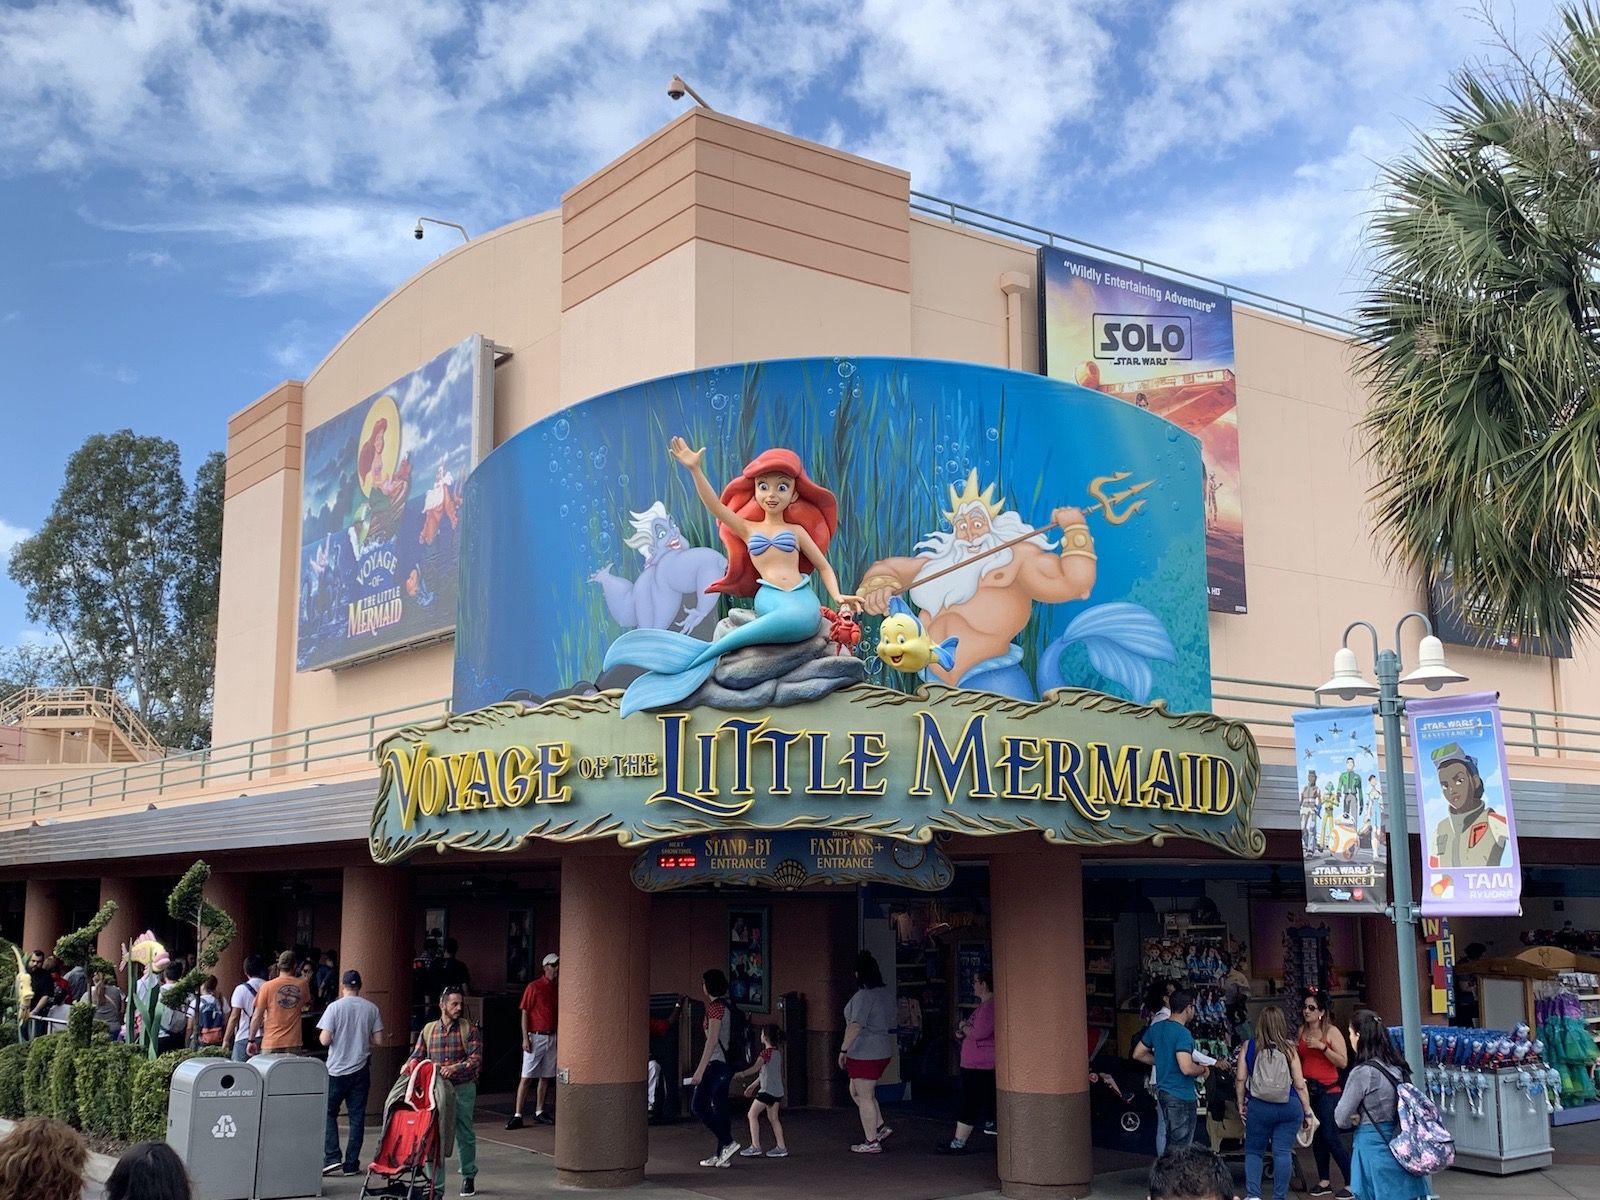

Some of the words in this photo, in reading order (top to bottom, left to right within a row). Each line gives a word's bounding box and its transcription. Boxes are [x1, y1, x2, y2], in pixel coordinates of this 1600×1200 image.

[1104, 272, 1161, 301] Entertaining
[1101, 323, 1185, 352] SOLO
[1113, 357, 1140, 366] STAR
[1141, 357, 1168, 366] WARS
[356, 551, 397, 586] VOYAGE
[363, 594, 376, 609] THE
[377, 586, 401, 605] LITTLE
[347, 598, 402, 638] MERMAID
[1421, 722, 1447, 731] STAR
[1447, 719, 1474, 729] WARS
[384, 741, 573, 831] VOYAGE
[578, 756, 609, 780] OF
[610, 753, 659, 778] THE
[644, 711, 890, 818] LITTLE
[908, 709, 1240, 821] MERMAID
[704, 838, 773, 857] STAND-BY
[810, 838, 884, 856] FASTPASS+
[710, 858, 767, 870] ENTRANCE
[817, 857, 874, 869] ENTRANCE
[1311, 866, 1340, 875] STAR
[1339, 866, 1368, 875] WARS
[1313, 877, 1367, 886] RESISTANCE
[1464, 872, 1513, 889] TAM
[1328, 888, 1352, 901] Disney
[1421, 917, 1440, 938] IN
[241, 1089, 254, 1097] ONLY
